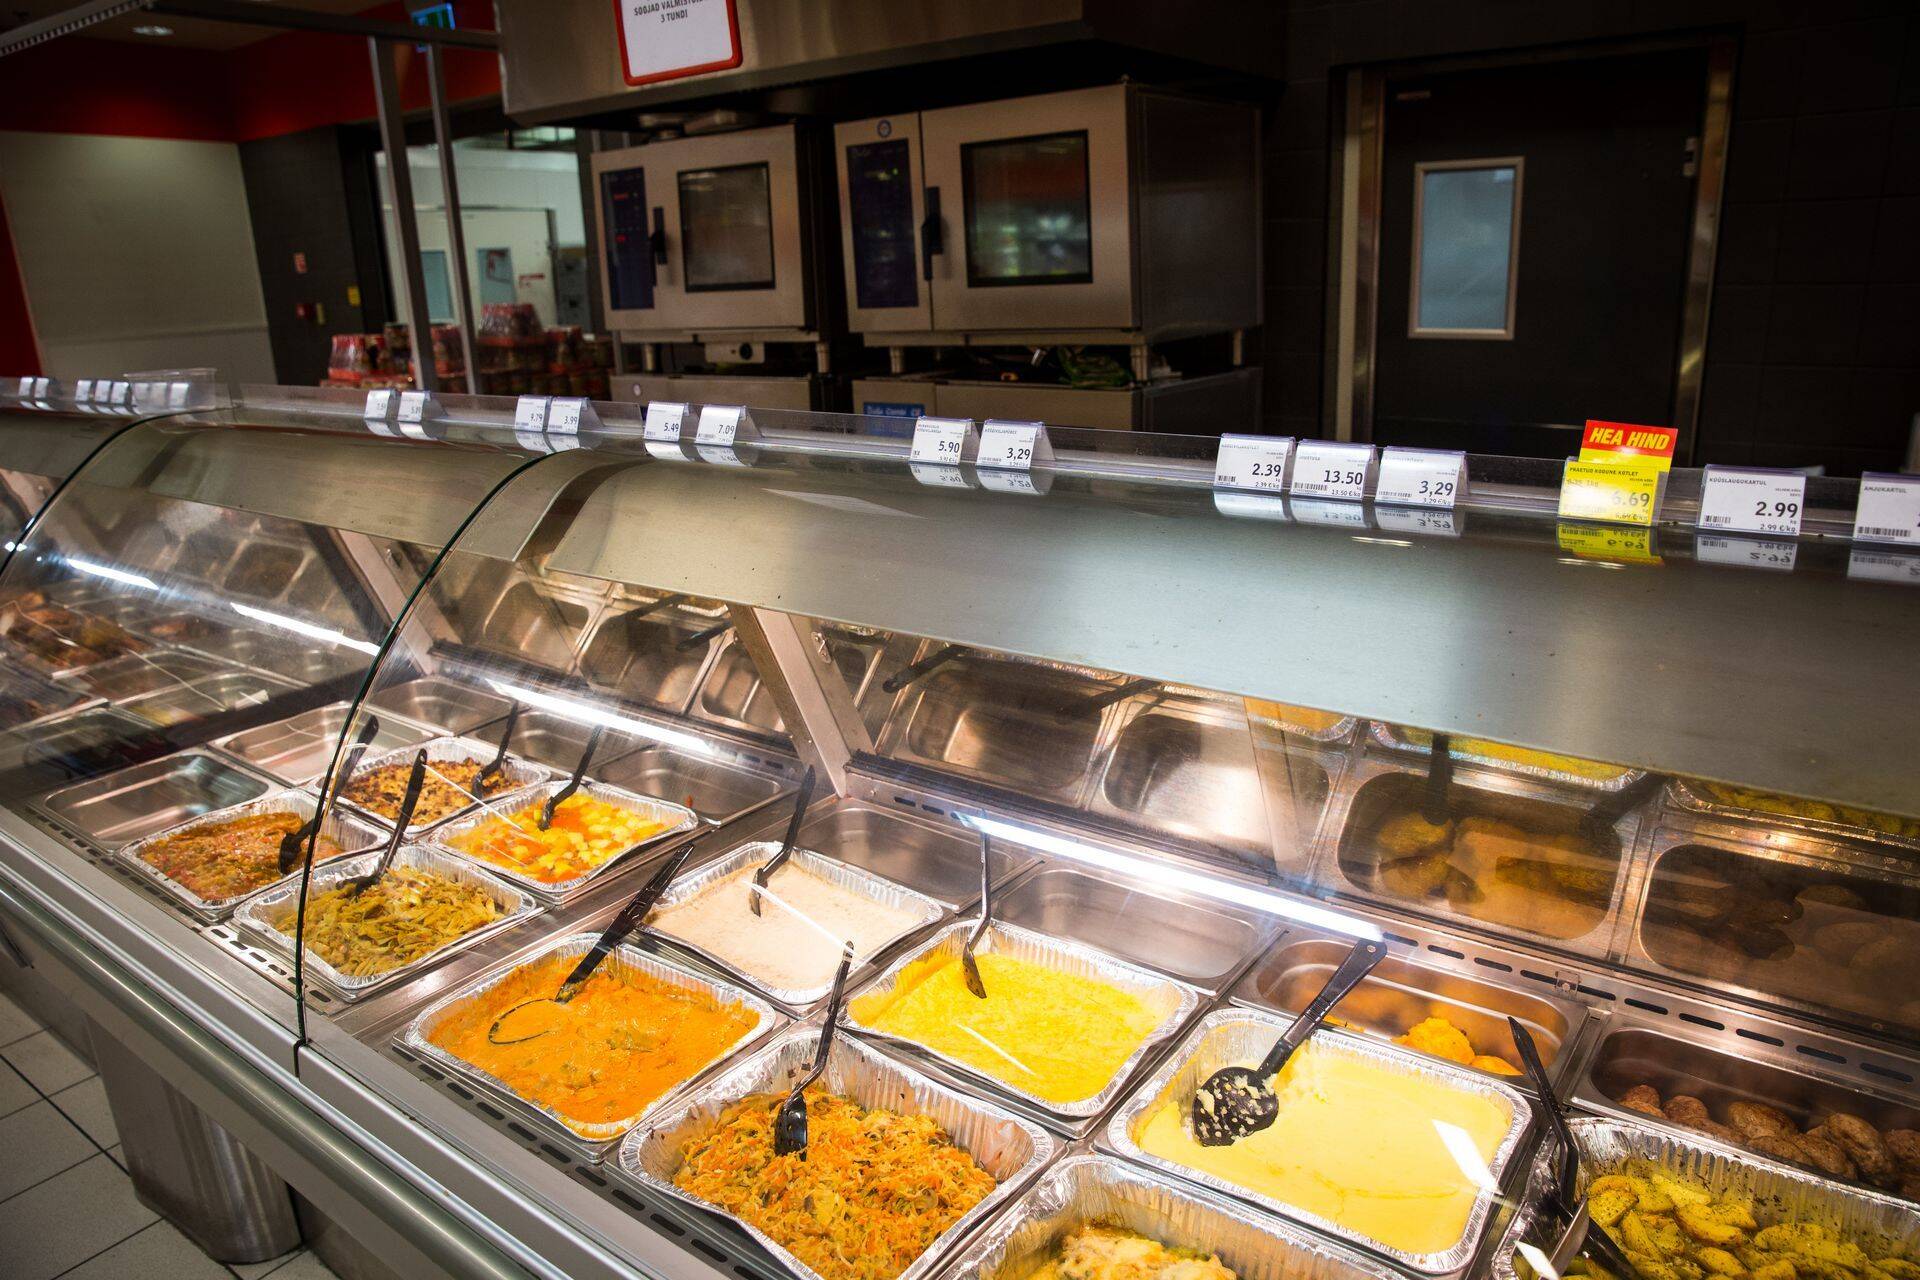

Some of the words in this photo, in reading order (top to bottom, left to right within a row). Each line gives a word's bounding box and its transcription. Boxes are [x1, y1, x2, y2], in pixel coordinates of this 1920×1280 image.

[634, 4, 660, 15] SOOJAD
[660, 14, 666, 23] 3
[666, 9, 688, 21] TUNDI
[564, 415, 578, 425] 3.99
[664, 422, 680, 433] 5.49
[718, 424, 735, 435] 7.09
[1588, 427, 1623, 446] HEA
[1625, 431, 1671, 450] HIND
[938, 440, 960, 454] 5.90
[1006, 447, 1031, 461] 3,29
[1251, 463, 1281, 478] 2.39
[1323, 470, 1363, 485] 13.50
[1418, 480, 1454, 498] 3,29
[1611, 489, 1651, 507] 6.69
[1754, 501, 1799, 518] 2.99
[1759, 523, 1777, 531] 2.99
